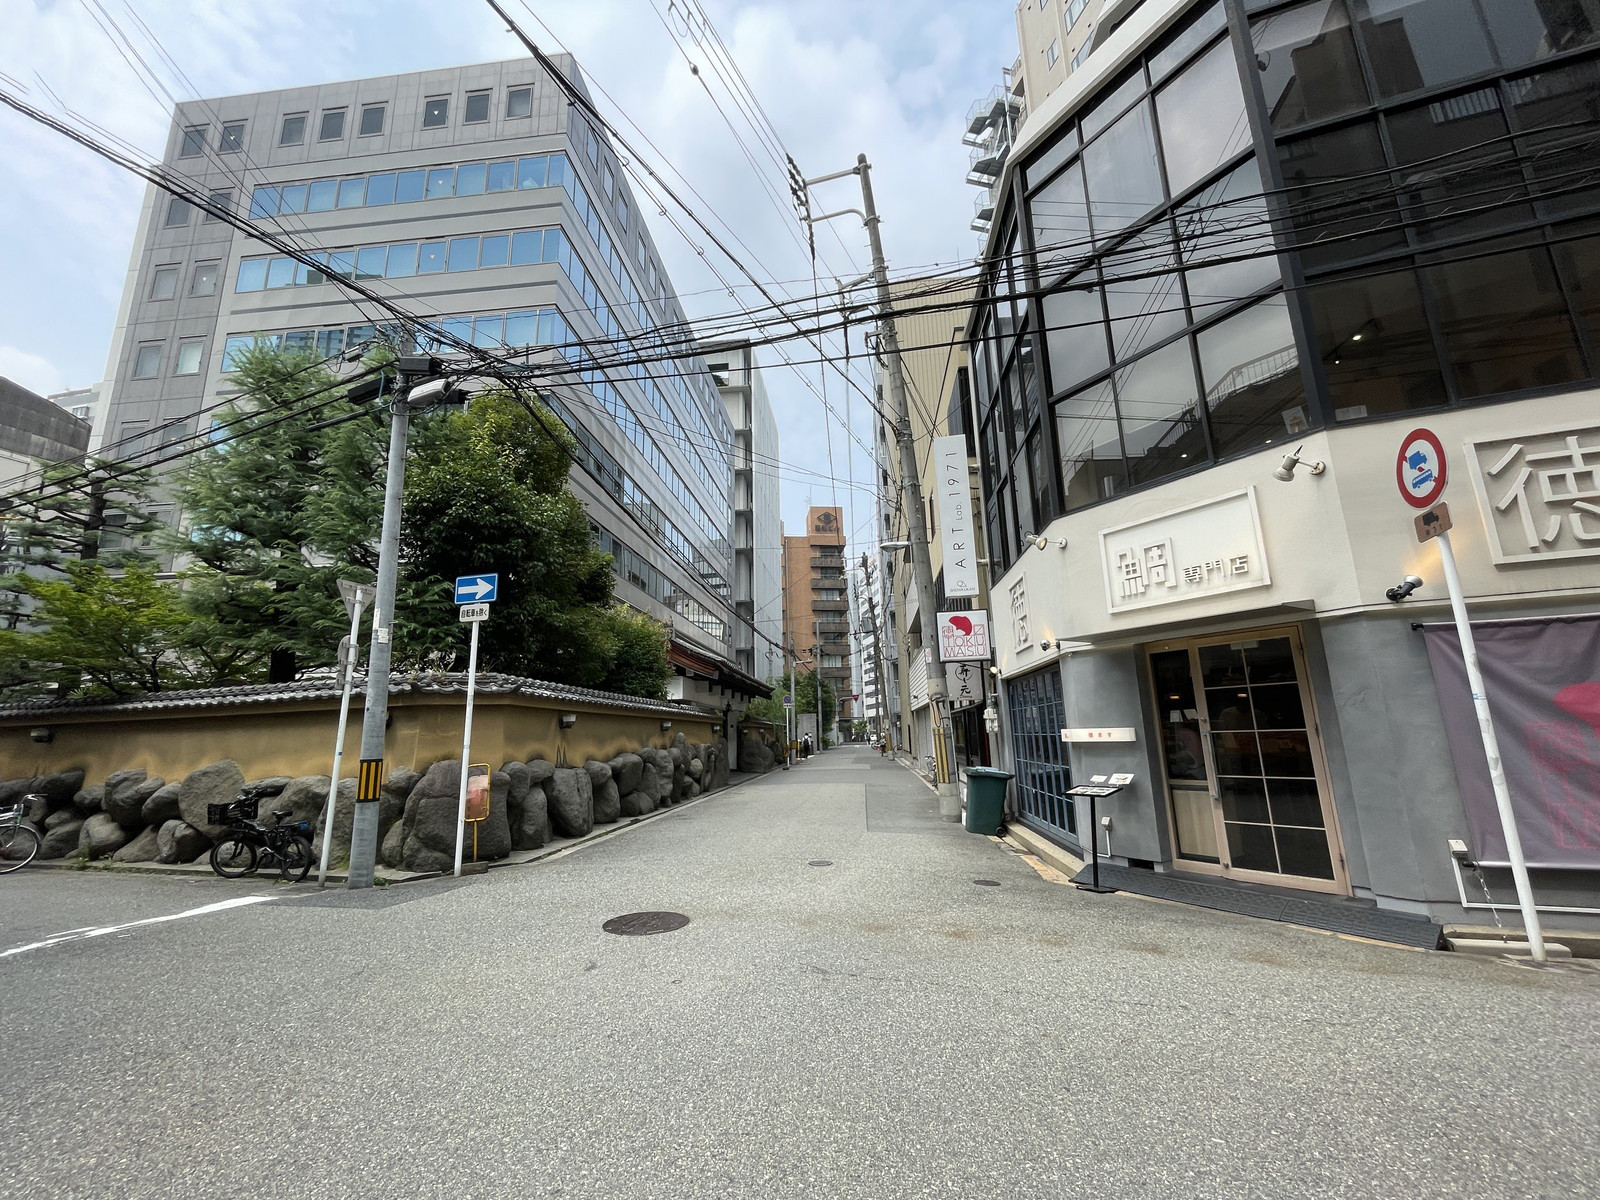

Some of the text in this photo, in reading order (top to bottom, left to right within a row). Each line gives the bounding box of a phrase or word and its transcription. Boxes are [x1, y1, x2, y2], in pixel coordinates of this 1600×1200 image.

[944, 451, 967, 570] ART Lab. 1971
[460, 608, 488, 619] 自転車を除く
[943, 636, 986, 647] TOKU
[944, 646, 987, 657] MASU
